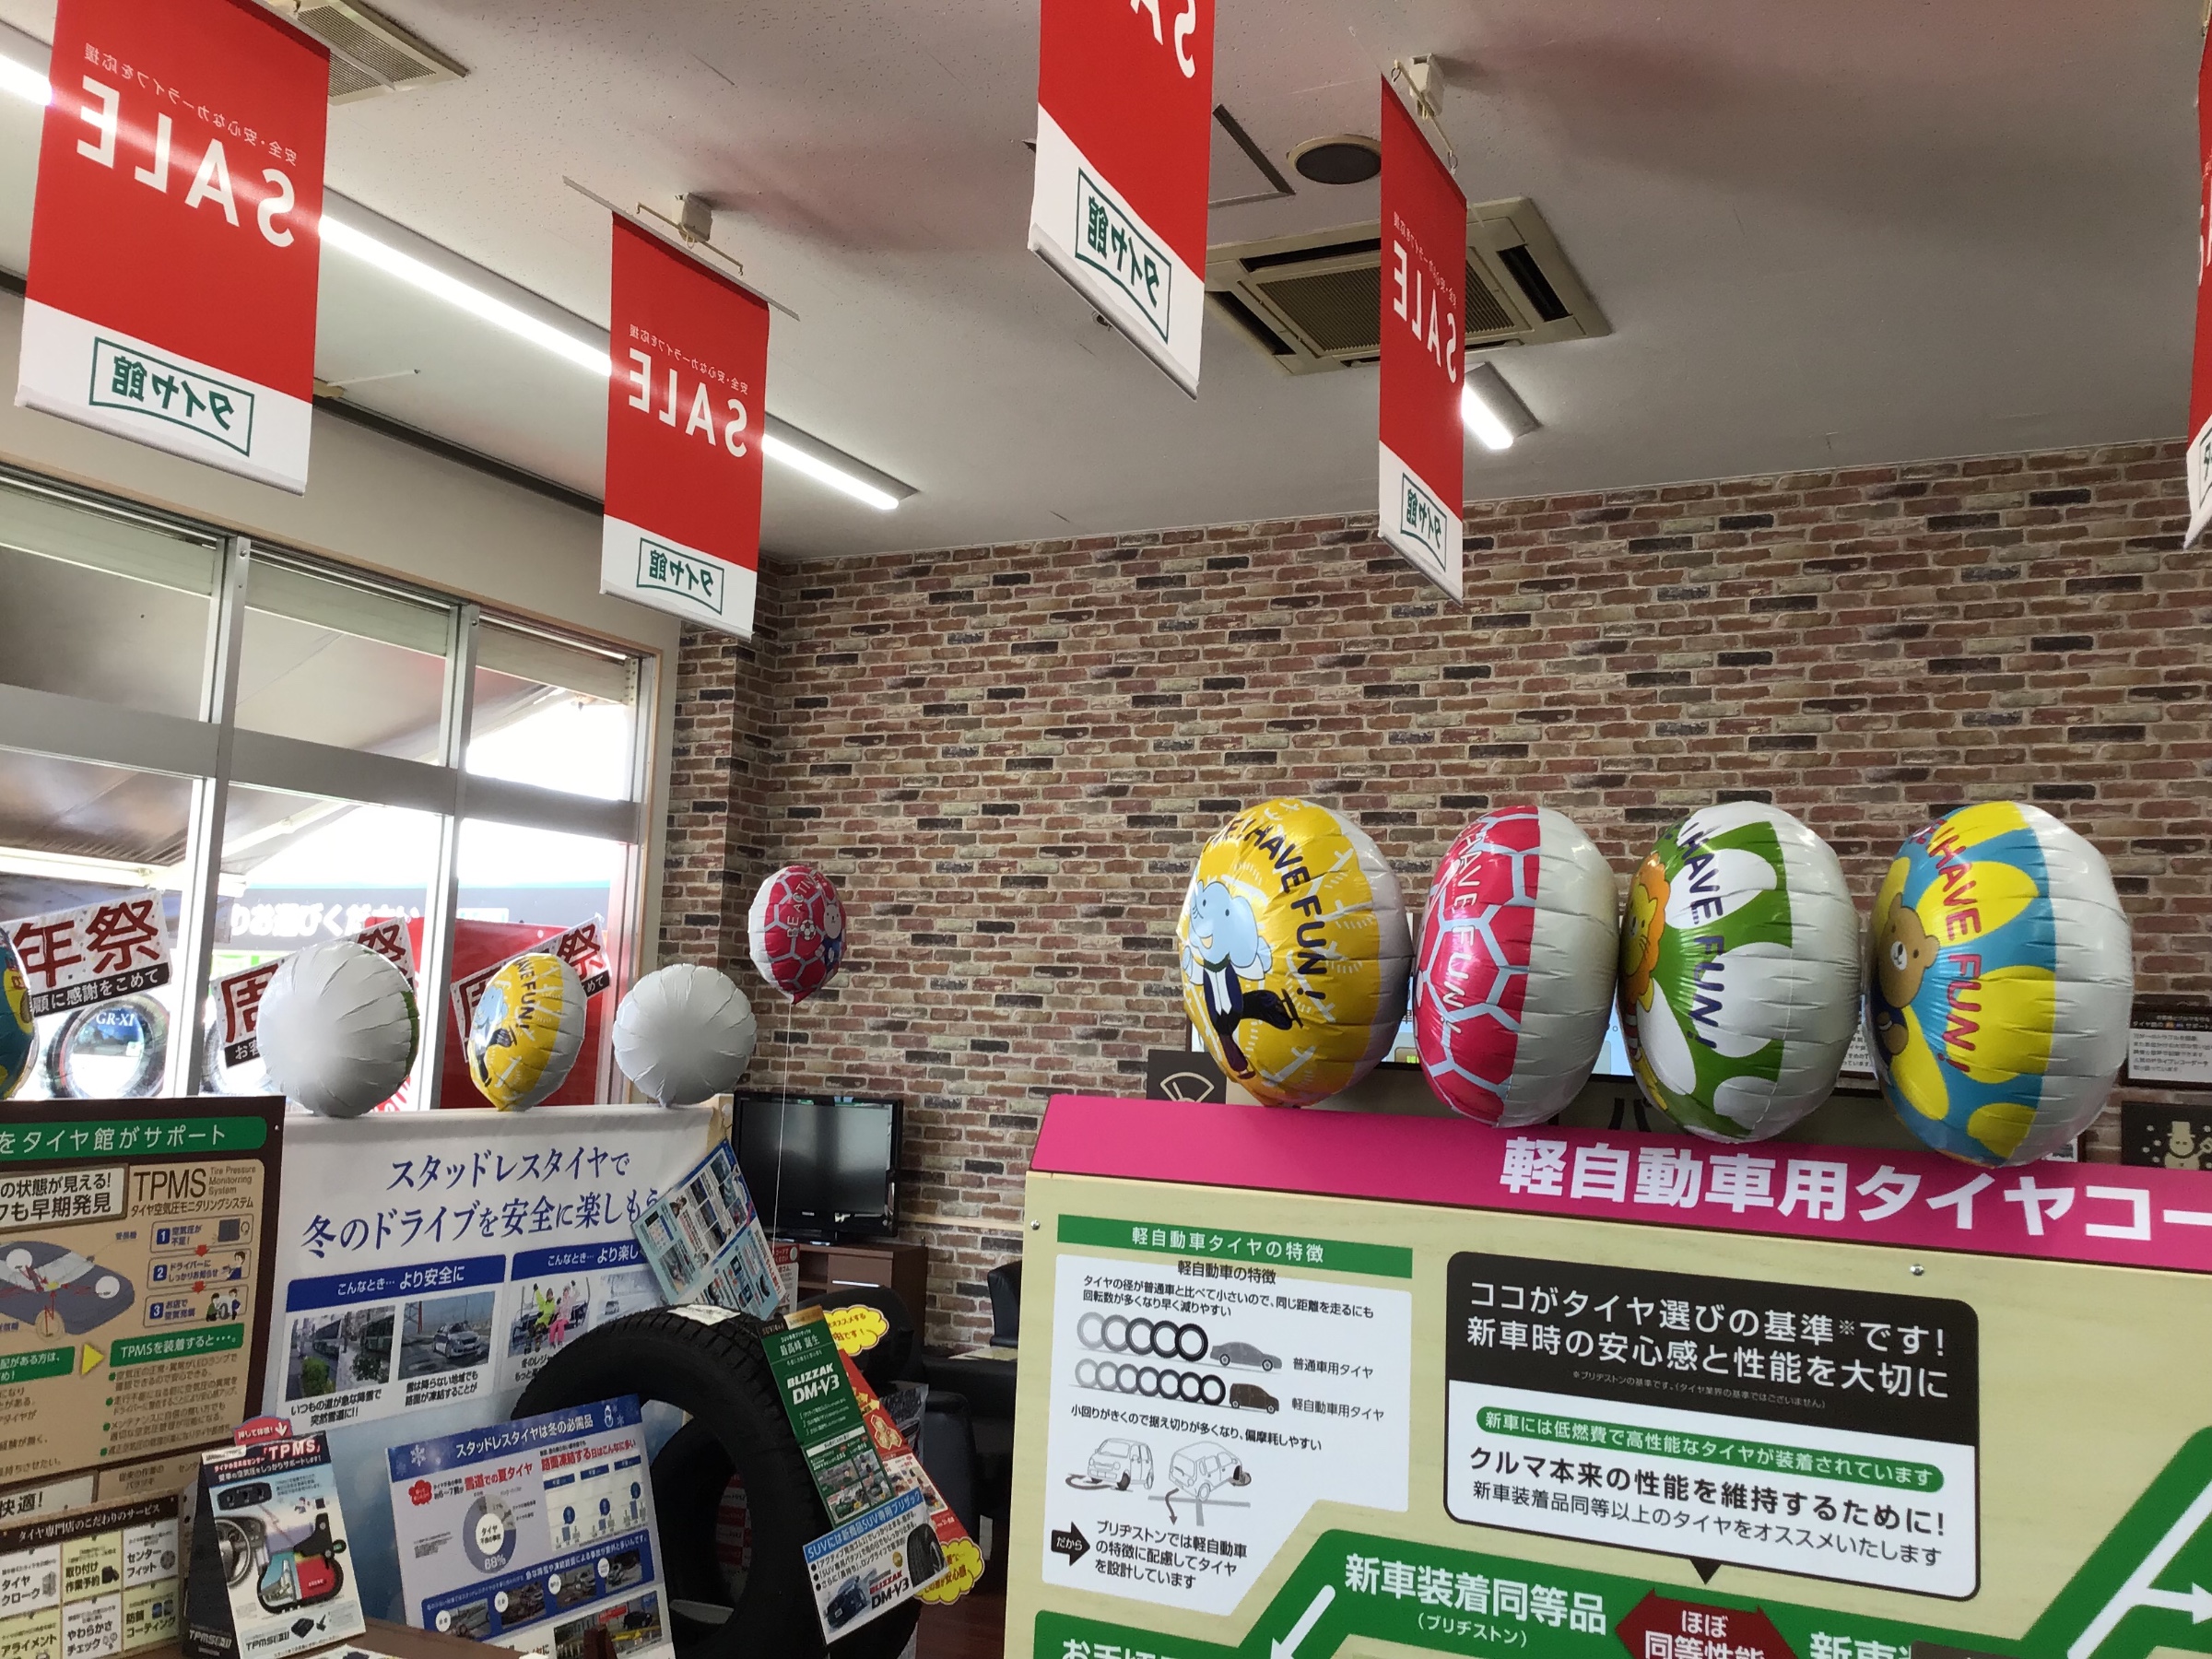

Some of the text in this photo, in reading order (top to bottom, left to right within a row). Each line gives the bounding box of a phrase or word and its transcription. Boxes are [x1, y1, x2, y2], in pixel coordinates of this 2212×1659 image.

[787, 916, 799, 937] BE
[1244, 825, 1327, 1001] HAVE FUN!
[1439, 832, 1483, 1034] HAVE FUN!
[1677, 831, 1725, 1049] HAVE FUN!
[1929, 835, 1983, 1074] HAVE FUN!
[516, 982, 537, 1030] FUN!
[0, 1124, 226, 1154] をタイヤ館がサポート
[134, 1168, 206, 1202] TPMS
[386, 1147, 630, 1192] スタッドレスタイヤで
[1500, 1136, 2212, 1242] 軽自動車用タイヤコー
[160, 1231, 166, 1242] 1
[1132, 1226, 1324, 1264] 軽自動車タイヤの特徴
[157, 1267, 164, 1279] 2
[399, 1265, 465, 1290] より安全に
[1177, 1259, 1277, 1286] 軽自動車の特徴
[153, 1305, 160, 1317] 3
[1082, 1288, 1232, 1319] 回転数が多くなり早く減りやすい
[1083, 1275, 1374, 1319] タイヤの径が普通車と比べて小さいので、同じ距離を走るにも
[1292, 1357, 1374, 1379] 普通車用タイヤ
[1466, 1315, 1948, 1399] 新車時の安心感と性能を大切に
[786, 1362, 834, 1389] BLIZZAK
[793, 1374, 841, 1406] DM-V3
[1291, 1396, 1384, 1420] 軽自動車用タイヤ
[455, 1413, 594, 1459] スタッドレスタイヤは冬の必需品
[1484, 1410, 1934, 1488] 新車には低燃費で高性能なタイヤが装着されています
[1469, 1447, 1946, 1536] クルマ本来の性能を維持するために!
[1097, 1520, 1248, 1559] ブリヂストンでは軽自動車
[1472, 1480, 1943, 1567] 新車装着品同等以上のタイヤをオススメいたします
[1055, 1535, 1084, 1551] だから
[1095, 1540, 1237, 1577] の特徴に配慮してタイヤ
[2, 1574, 30, 1592] タイヤ
[1094, 1559, 1196, 1590] を設計しています
[871, 1577, 910, 1609] DM-V3
[1345, 1552, 1607, 1636] 新車装着同等品
[1681, 1609, 1729, 1639] ほぼ
